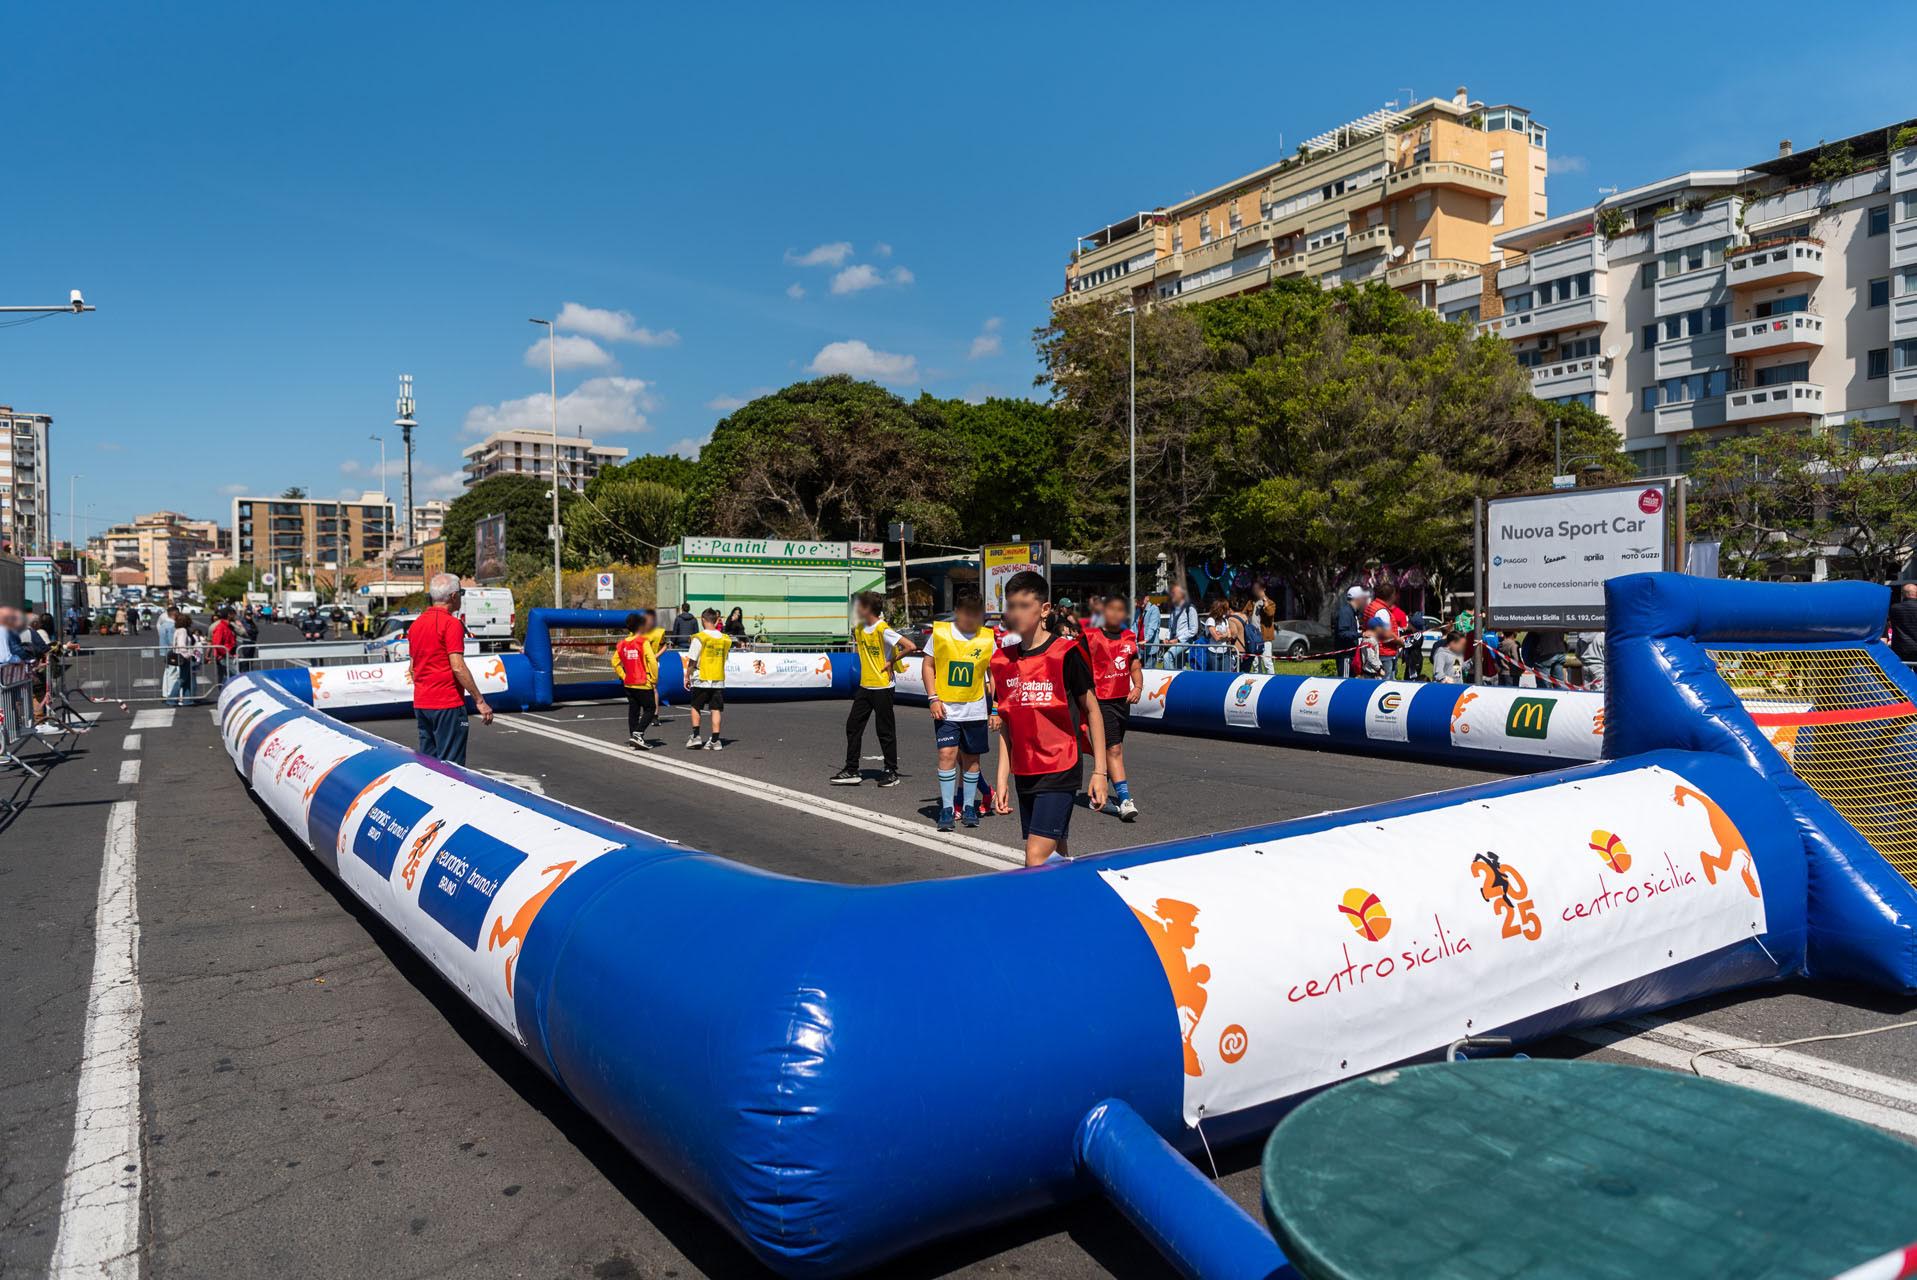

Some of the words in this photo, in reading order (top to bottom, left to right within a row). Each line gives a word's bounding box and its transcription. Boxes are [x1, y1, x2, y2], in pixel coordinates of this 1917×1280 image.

[1501, 525, 1554, 541] Nuova
[1558, 520, 1608, 541] Sport
[1612, 516, 1646, 533] Car
[711, 540, 768, 554] Panini
[1503, 581, 1512, 590] Le
[1513, 581, 1537, 589] nuove
[1538, 579, 1599, 588] concessionarie
[1509, 614, 1535, 622] Motoplex
[1021, 680, 1054, 691] catania
[370, 807, 391, 828] euronics
[439, 850, 469, 878] euronics
[467, 867, 499, 898] bruno.it
[438, 875, 458, 897] BRUNO
